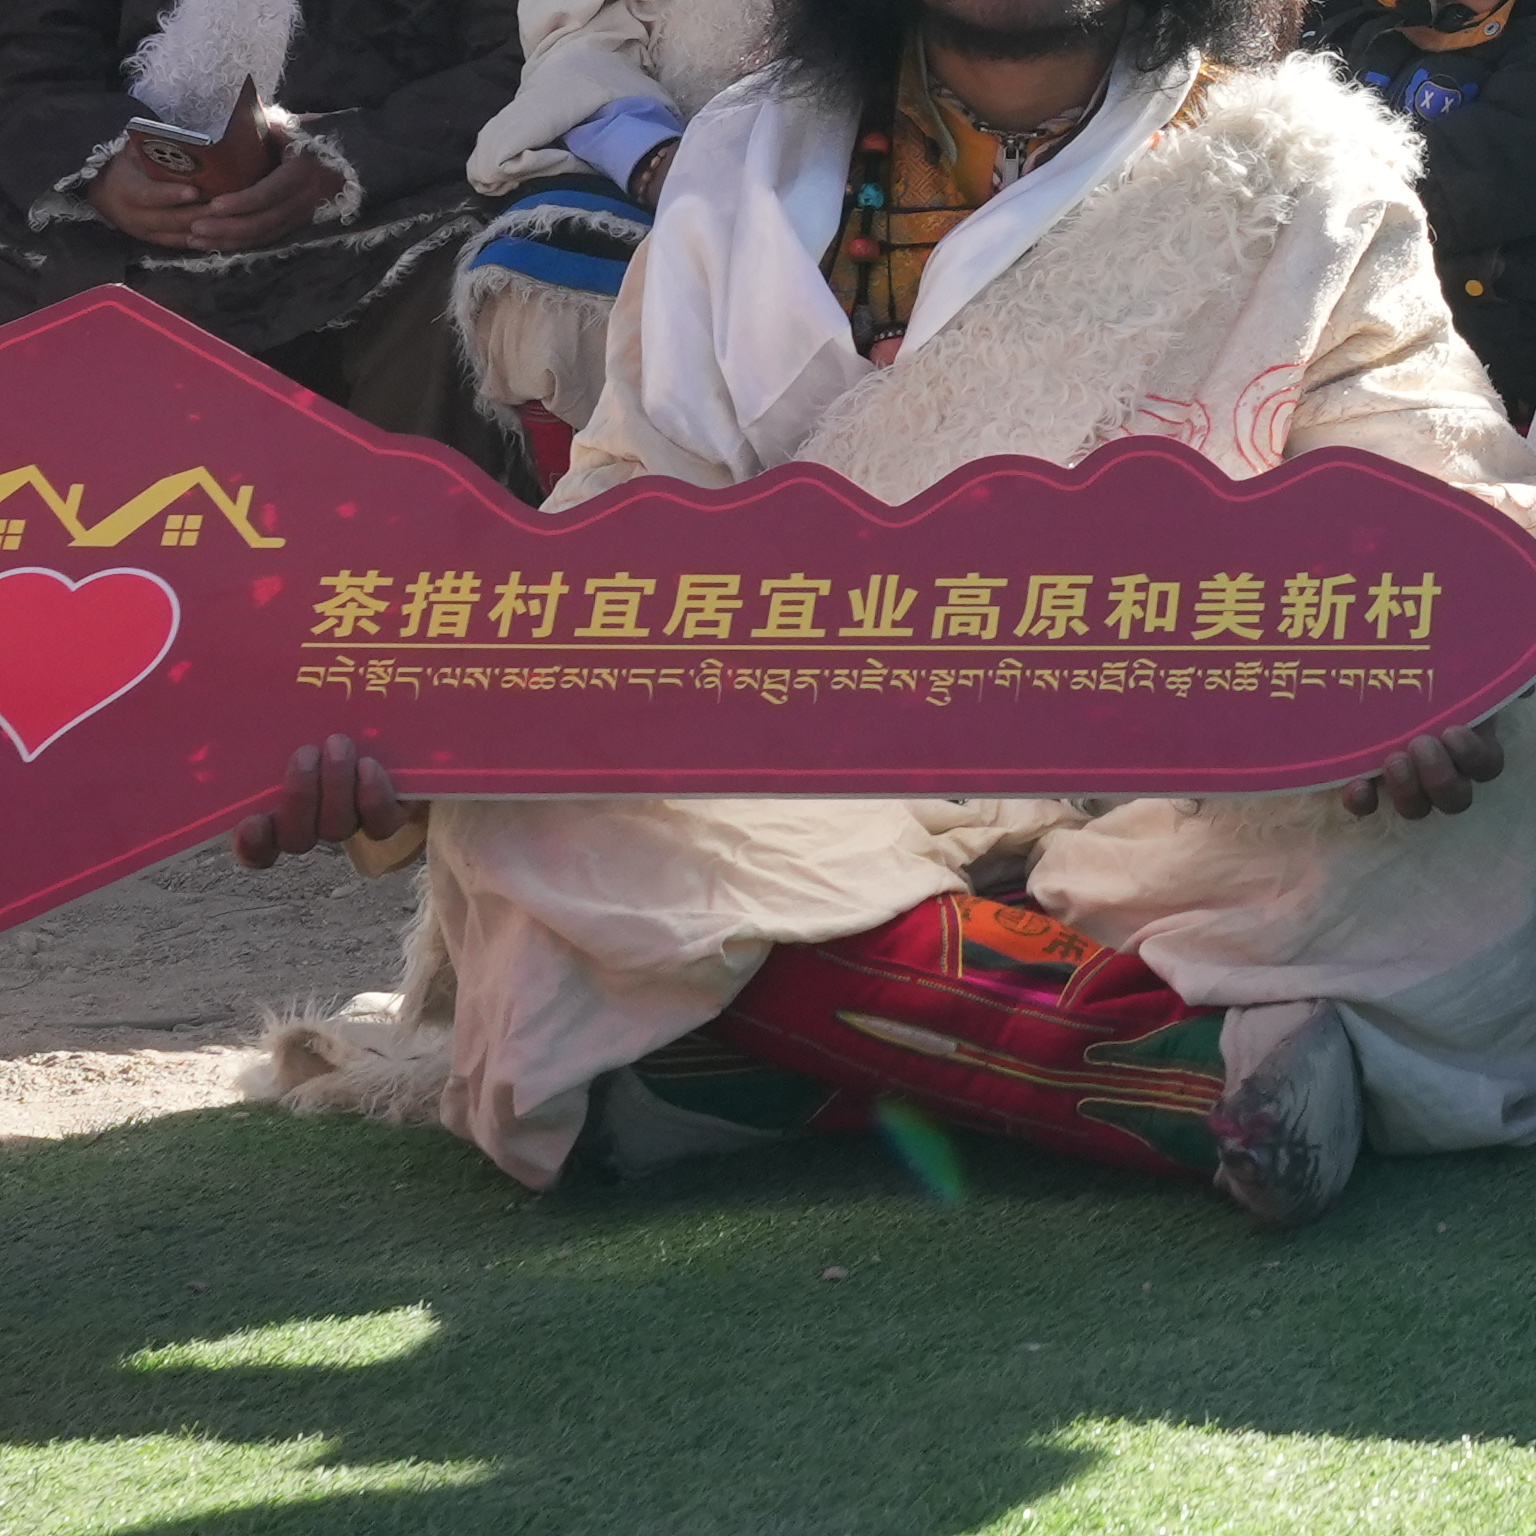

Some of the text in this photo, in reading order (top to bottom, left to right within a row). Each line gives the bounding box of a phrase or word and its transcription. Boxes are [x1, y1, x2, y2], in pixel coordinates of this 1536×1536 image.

[309, 569, 1442, 640] 茶措村宜居宜业高原和美新村
